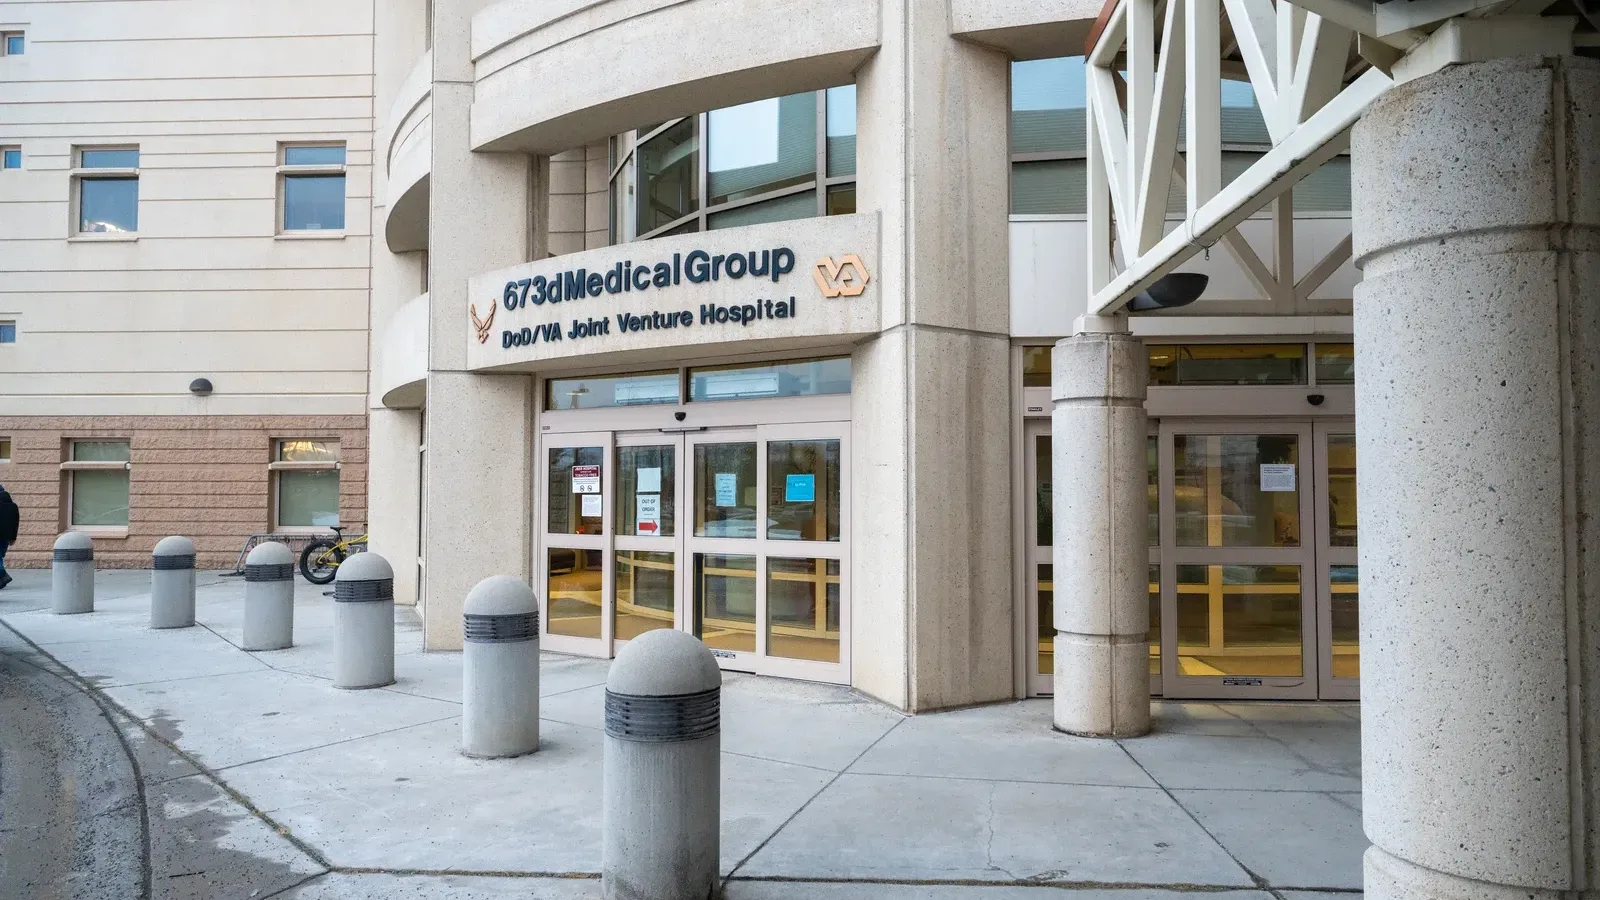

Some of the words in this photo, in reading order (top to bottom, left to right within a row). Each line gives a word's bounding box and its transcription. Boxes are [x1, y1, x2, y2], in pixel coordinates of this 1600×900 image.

[502, 322, 562, 349] DoD/VA
[567, 317, 610, 340] Joint
[616, 310, 694, 333] Venture
[700, 296, 796, 327] Hospital
